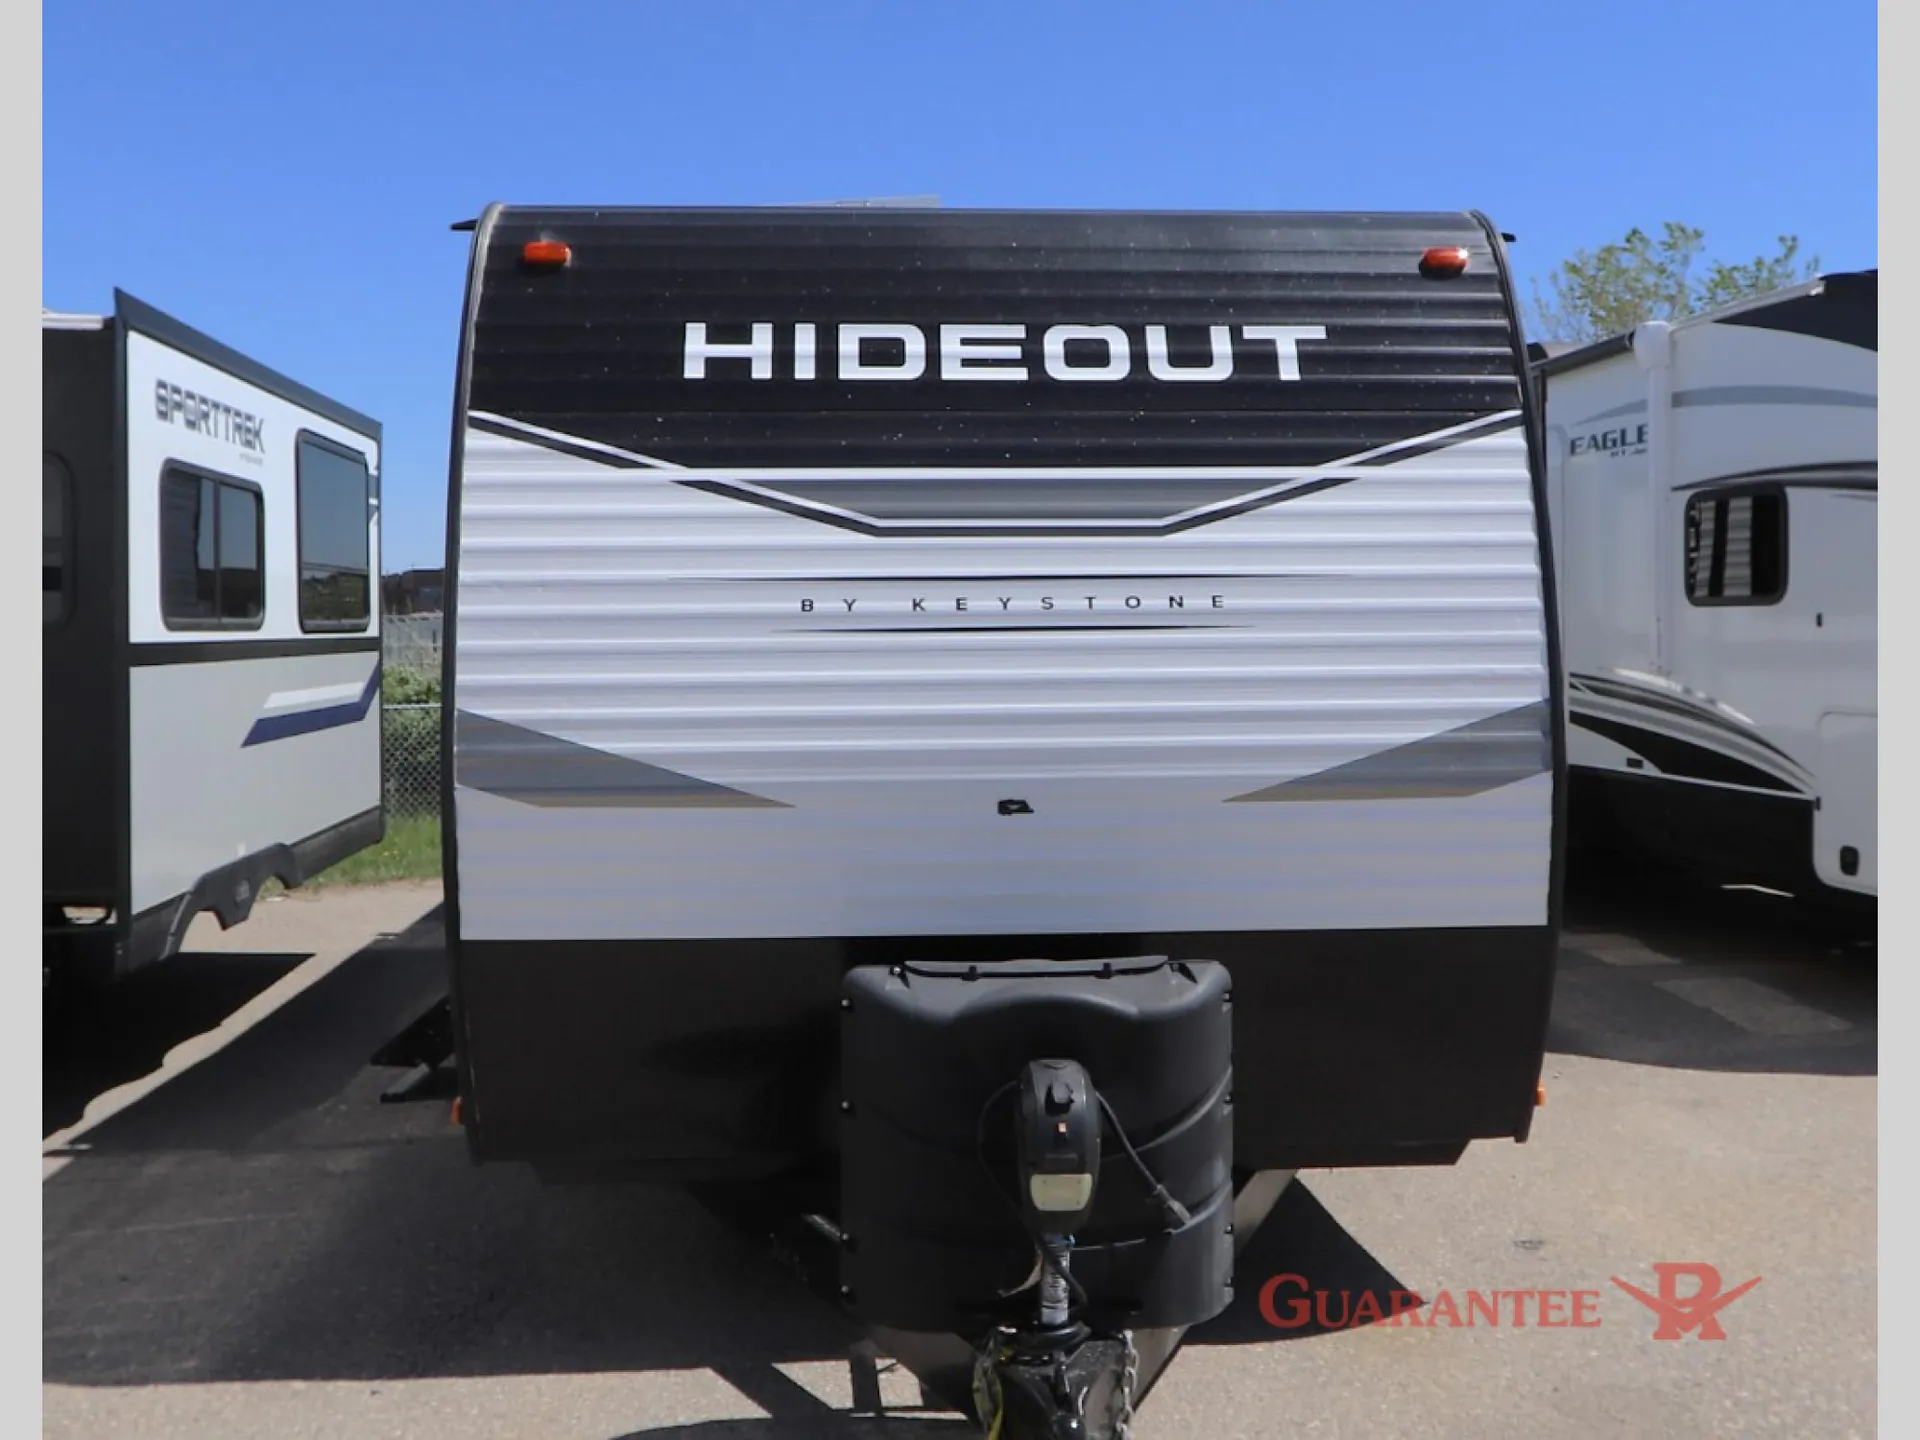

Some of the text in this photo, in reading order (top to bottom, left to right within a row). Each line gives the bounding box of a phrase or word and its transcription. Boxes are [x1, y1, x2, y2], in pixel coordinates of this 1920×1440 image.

[682, 322, 1327, 382] HIDEOUT
[155, 378, 265, 454] SPORTTREK
[1570, 423, 1648, 457] EAGLE
[801, 594, 1225, 613] BY KEYSTONE
